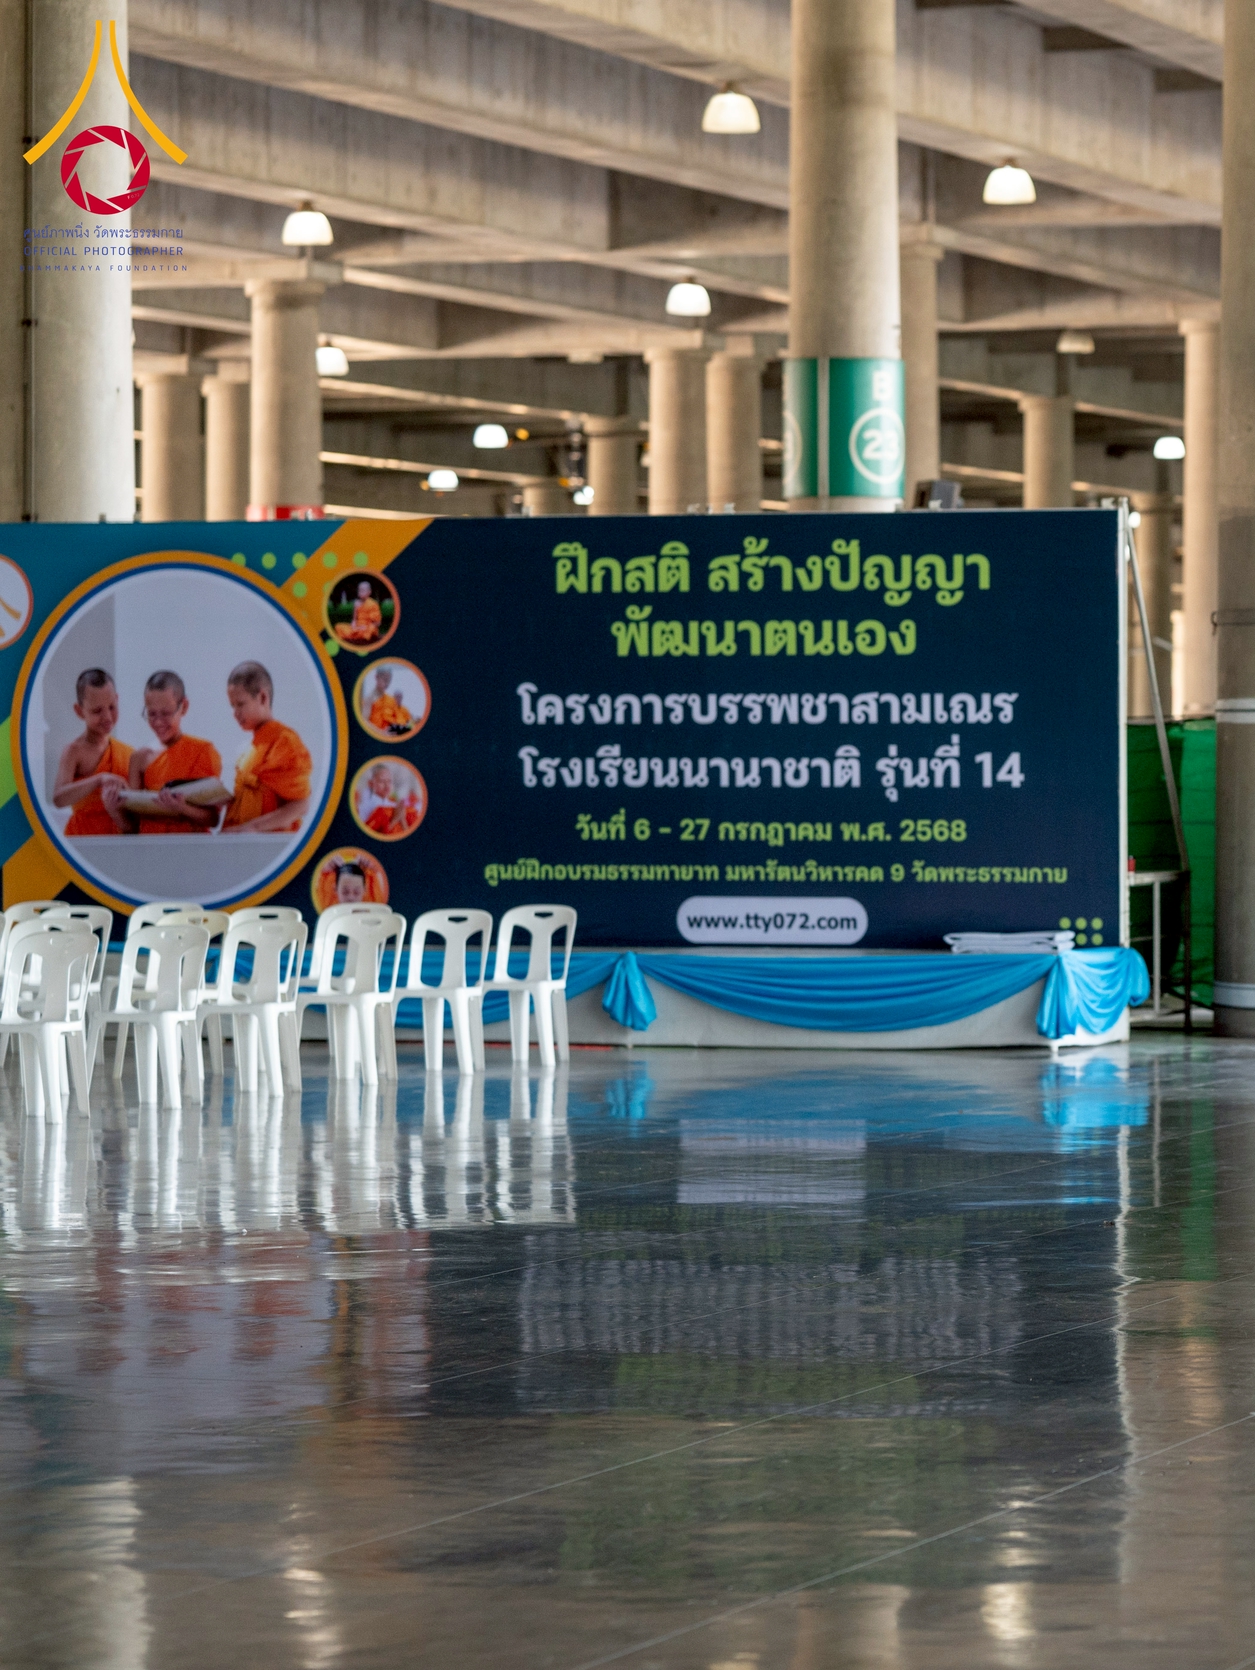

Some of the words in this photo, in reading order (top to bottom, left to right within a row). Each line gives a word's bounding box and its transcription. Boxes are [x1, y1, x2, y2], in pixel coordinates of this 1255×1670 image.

[554, 542, 690, 594] ฝึกสติ
[710, 538, 991, 607] สร้างปัญญา
[612, 604, 917, 657] พัฒนาตนเอง
[518, 684, 1019, 725] โครงการบรรพชาสามเณร
[519, 745, 861, 788] โรงเรียนนานาชาติ
[877, 735, 961, 803] รุ่นที่
[976, 753, 1026, 789] 14
[577, 810, 626, 841] วันที่
[635, 820, 651, 841] 6
[681, 820, 711, 841] 27
[720, 823, 833, 847] กรกฎาคม
[841, 823, 892, 842] พ.ศ.
[901, 820, 968, 842] 2568
[486, 860, 720, 887] ศูนย์ฝึกอบรมธรรมทายาท
[727, 861, 884, 882] มหารัตนวิหารคด
[892, 865, 905, 883] 9
[913, 861, 1068, 884] วัดพระธรรมกาย
[689, 914, 858, 933] www.tty072.com
